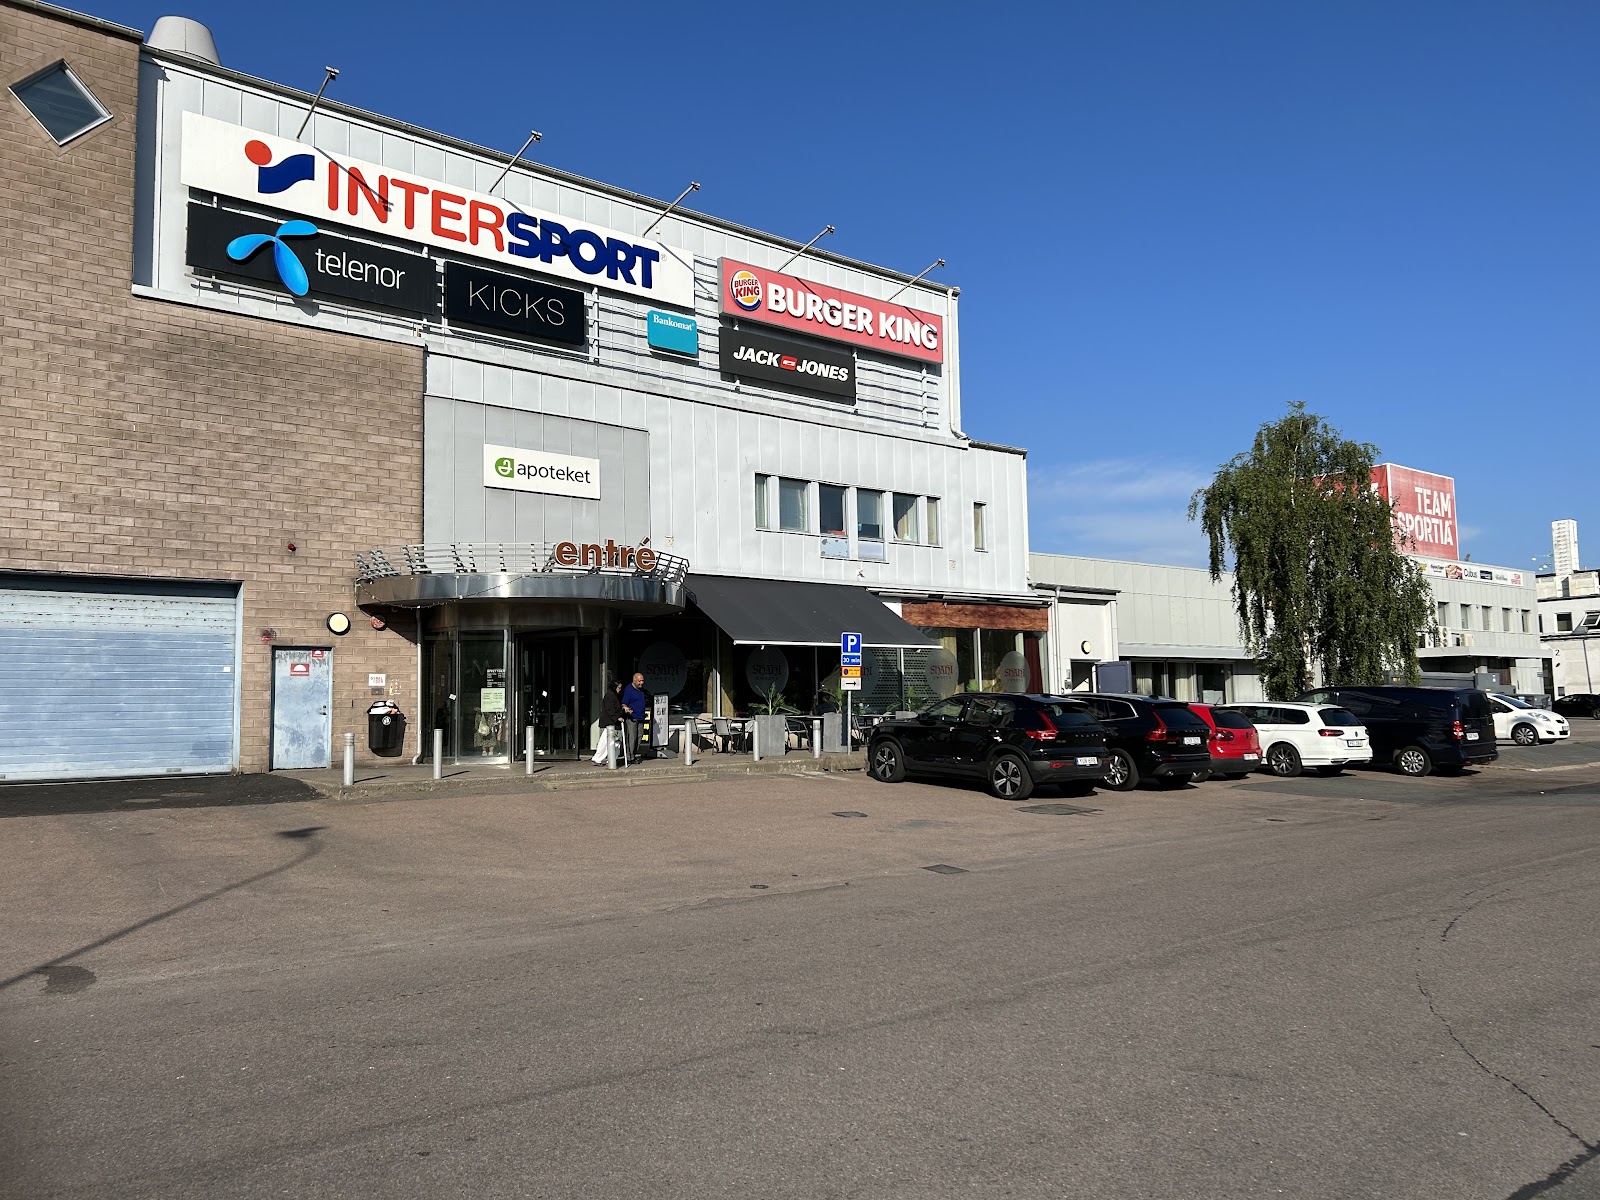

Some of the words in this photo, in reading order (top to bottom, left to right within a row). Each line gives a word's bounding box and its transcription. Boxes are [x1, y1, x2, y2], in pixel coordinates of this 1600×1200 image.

[327, 160, 661, 290] INTERSPORT
[314, 247, 406, 290] telenor
[733, 277, 760, 290] BURGER
[467, 281, 566, 328] KICKS
[735, 284, 761, 299] KING
[767, 281, 874, 336] BURGER
[878, 310, 939, 351] KING
[732, 345, 779, 368] JACK
[795, 358, 849, 382] JONES
[516, 461, 591, 484] apoteket
[1414, 486, 1452, 519] TEAM
[1397, 511, 1454, 547] SPORTIA
[554, 536, 657, 572] entré
[847, 635, 858, 652] P
